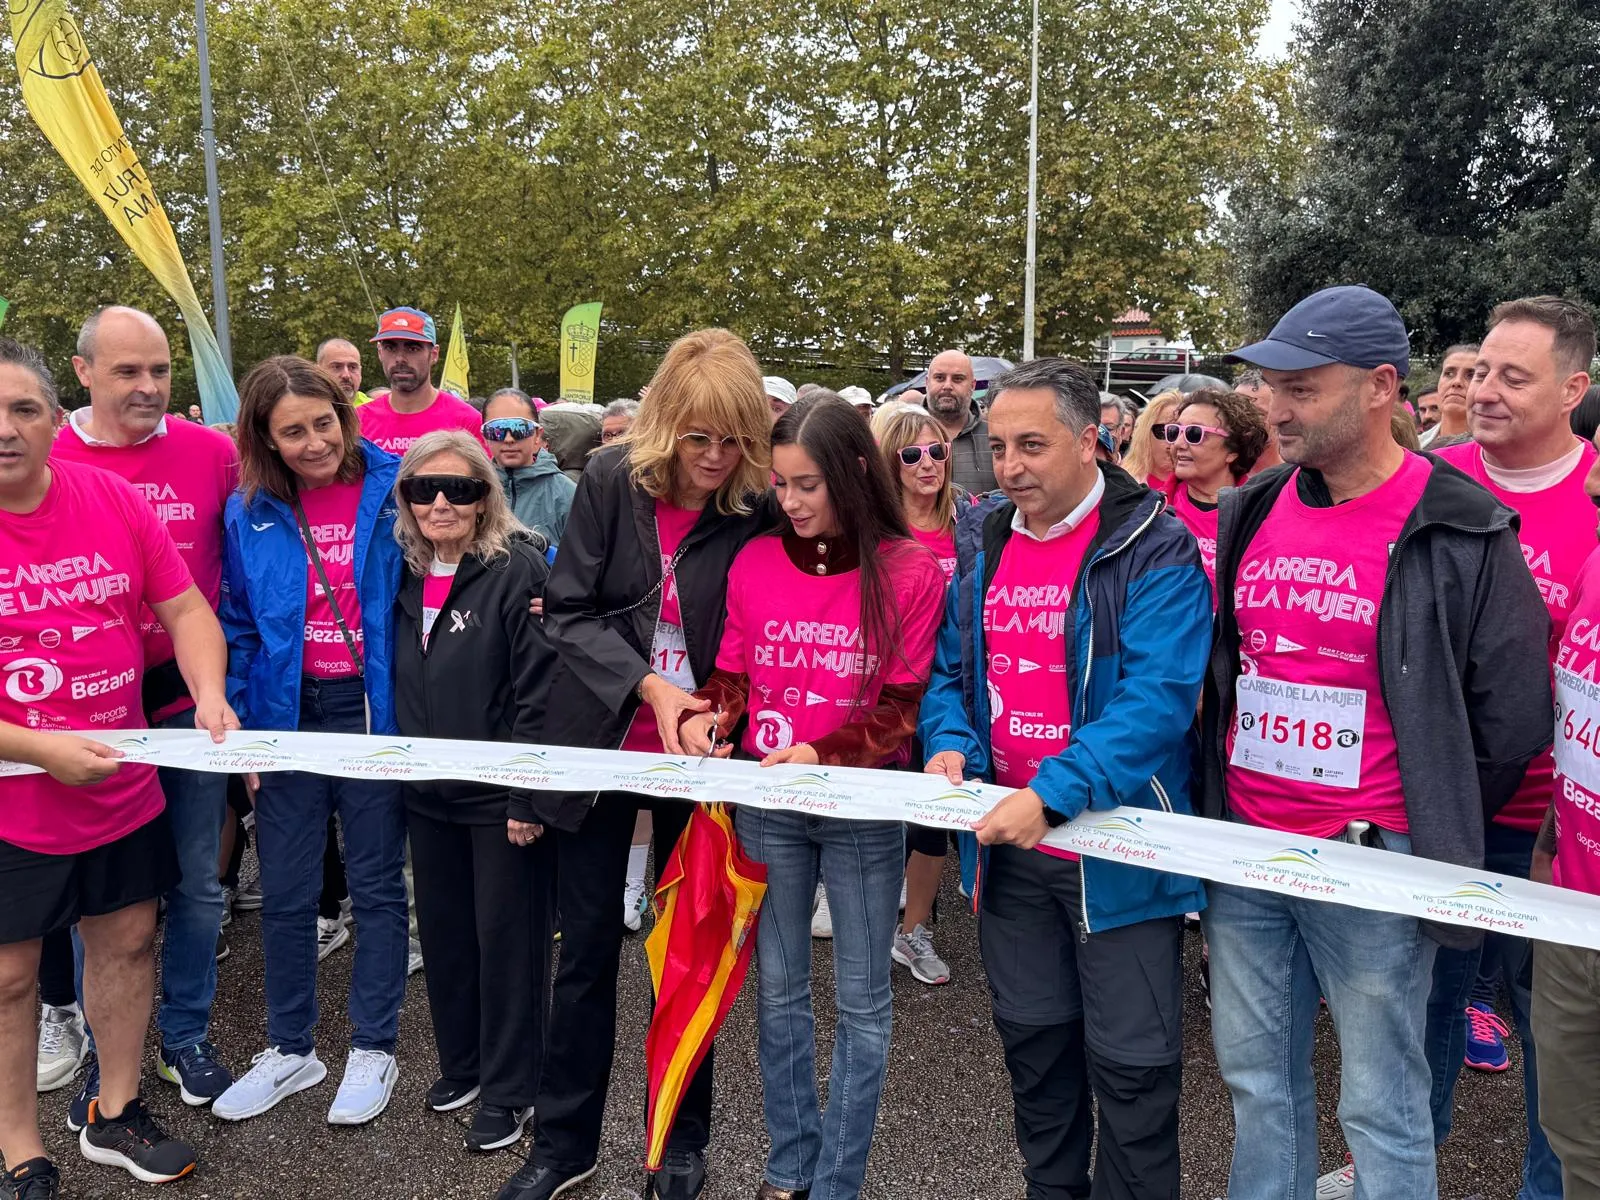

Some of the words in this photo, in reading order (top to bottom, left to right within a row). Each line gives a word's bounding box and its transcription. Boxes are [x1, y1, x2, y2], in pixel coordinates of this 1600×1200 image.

[1242, 556, 1357, 591] CARRERA
[0, 592, 19, 617] E
[19, 587, 62, 613] LA
[56, 572, 131, 606] MUJER
[984, 584, 1070, 609] CARRERA
[1234, 585, 1246, 609] E
[1247, 584, 1281, 609] LA
[1286, 585, 1376, 626] MUJER
[764, 619, 865, 650] CARRERA
[991, 608, 1024, 634] LA
[754, 645, 775, 667] DE
[779, 646, 808, 669] LA
[811, 649, 882, 678] MUJER
[71, 667, 136, 701] Bezana
[1238, 678, 1284, 698] CARRERA
[1285, 687, 1301, 701] DE
[1302, 688, 1321, 703] LA
[1322, 690, 1364, 708] MUJER
[1009, 716, 1071, 740] Bezan
[1258, 711, 1333, 751] 1518
[762, 795, 783, 803] vive
[785, 795, 798, 804] el
[798, 797, 839, 811] deporte
[1563, 777, 1600, 822] Beza
[914, 810, 935, 820] vive
[938, 812, 951, 822] el
[952, 814, 972, 828] dep
[1071, 835, 1094, 848] vive
[1098, 836, 1111, 850] el
[1112, 843, 1157, 861] deporte
[1244, 870, 1269, 881] vive
[1273, 874, 1286, 885] el
[1289, 877, 1336, 895] deporte
[1426, 906, 1451, 916] vive
[1457, 909, 1470, 920] el
[1474, 913, 1525, 930] deporte
[1437, 898, 1447, 906] DE
[1449, 900, 1474, 911] SANTA
[1474, 905, 1496, 915] CRUZ
[1496, 908, 1506, 917] DE
[1507, 911, 1538, 923] BEZANA
